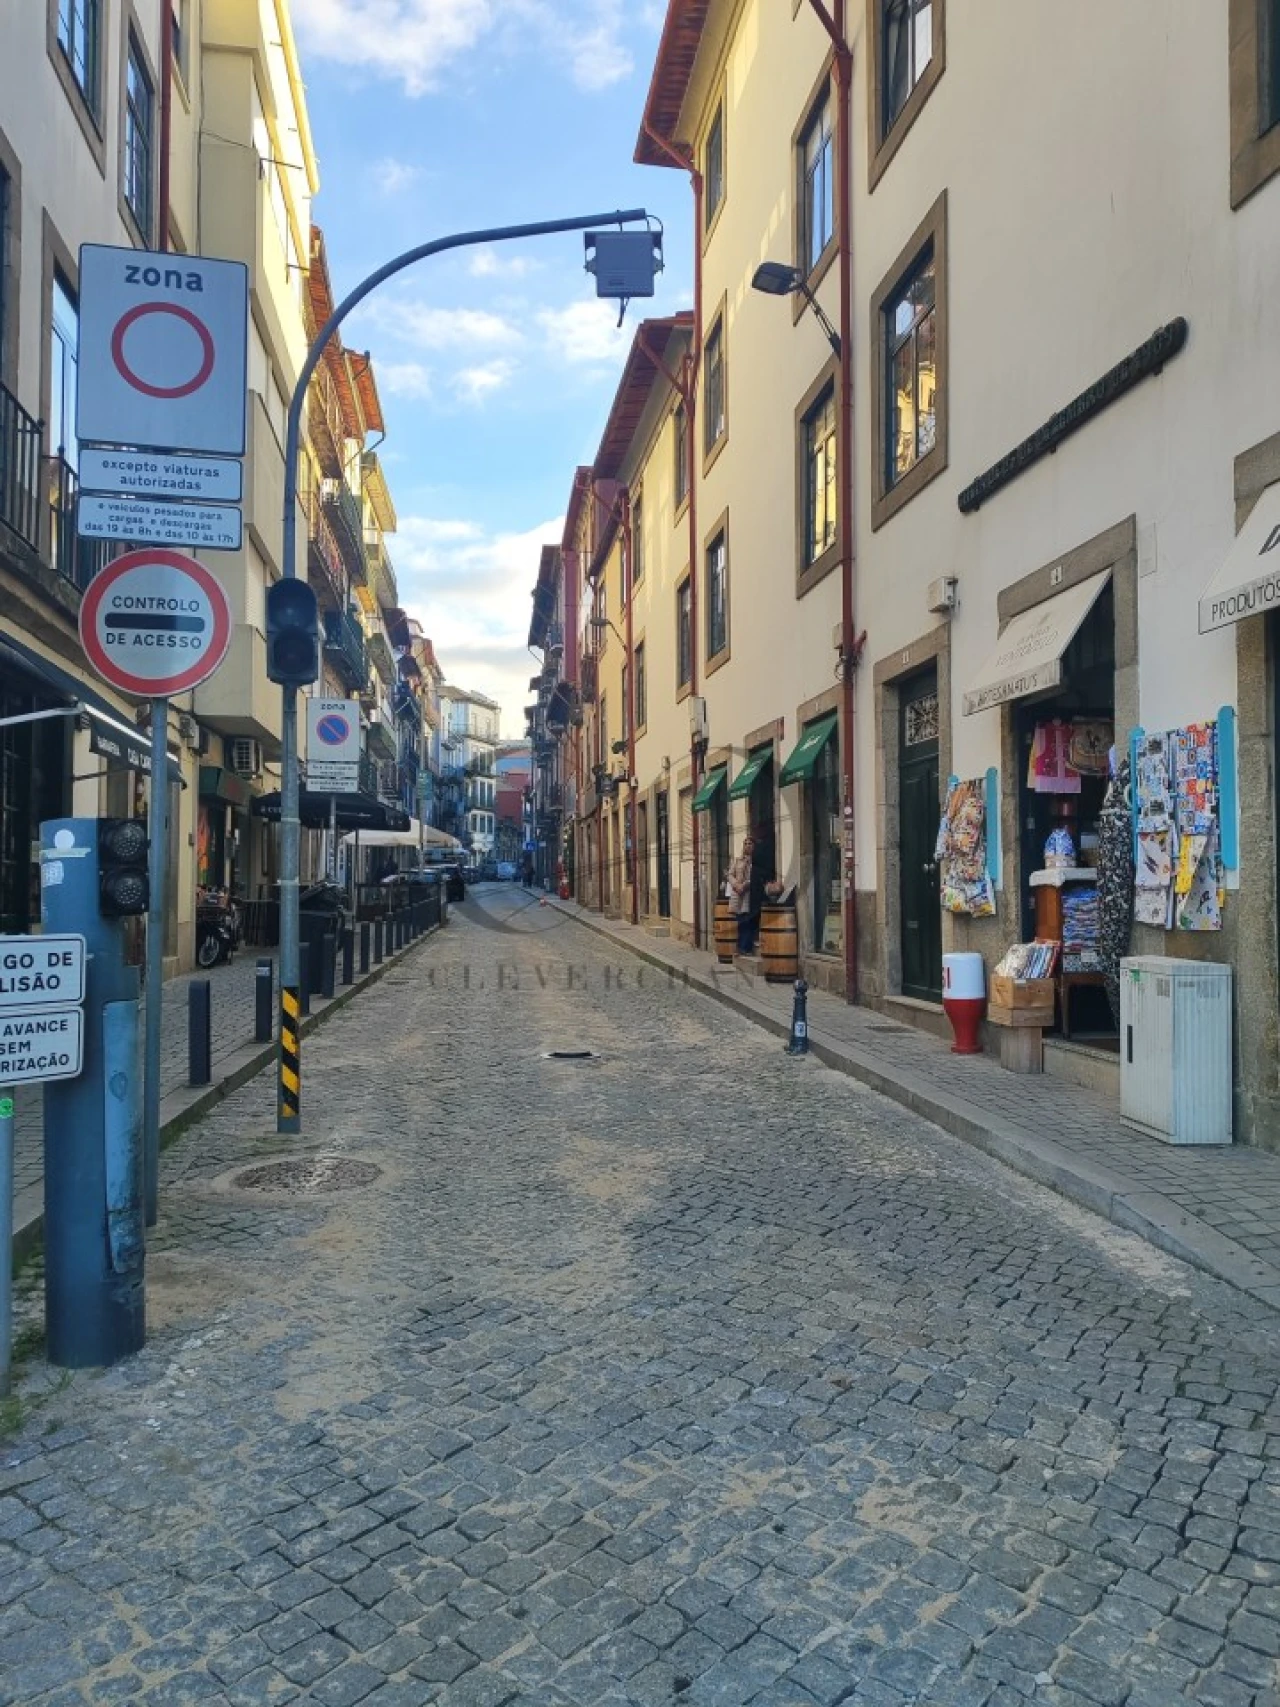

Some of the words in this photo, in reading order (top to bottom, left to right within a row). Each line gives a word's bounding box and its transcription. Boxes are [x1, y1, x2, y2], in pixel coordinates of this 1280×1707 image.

[124, 265, 203, 292] zona
[102, 460, 158, 473] excepto
[163, 463, 219, 477] viaturas
[120, 475, 202, 490] autorizadas
[108, 514, 143, 525] cargas
[159, 518, 212, 530] descargas
[154, 507, 196, 519] pesados
[199, 511, 223, 521] para
[84, 521, 104, 531] das
[106, 523, 118, 532] 19
[138, 525, 152, 536] 8h
[164, 529, 184, 539] das
[187, 531, 199, 540] 10
[217, 534, 234, 543] 17h
[112, 595, 200, 612] CONTROLO
[106, 632, 126, 645] DE
[133, 634, 202, 649] ACESSO
[47, 951, 74, 968] DE
[3, 1019, 69, 1037] AVANCE
[0, 1040, 31, 1055] SEM
